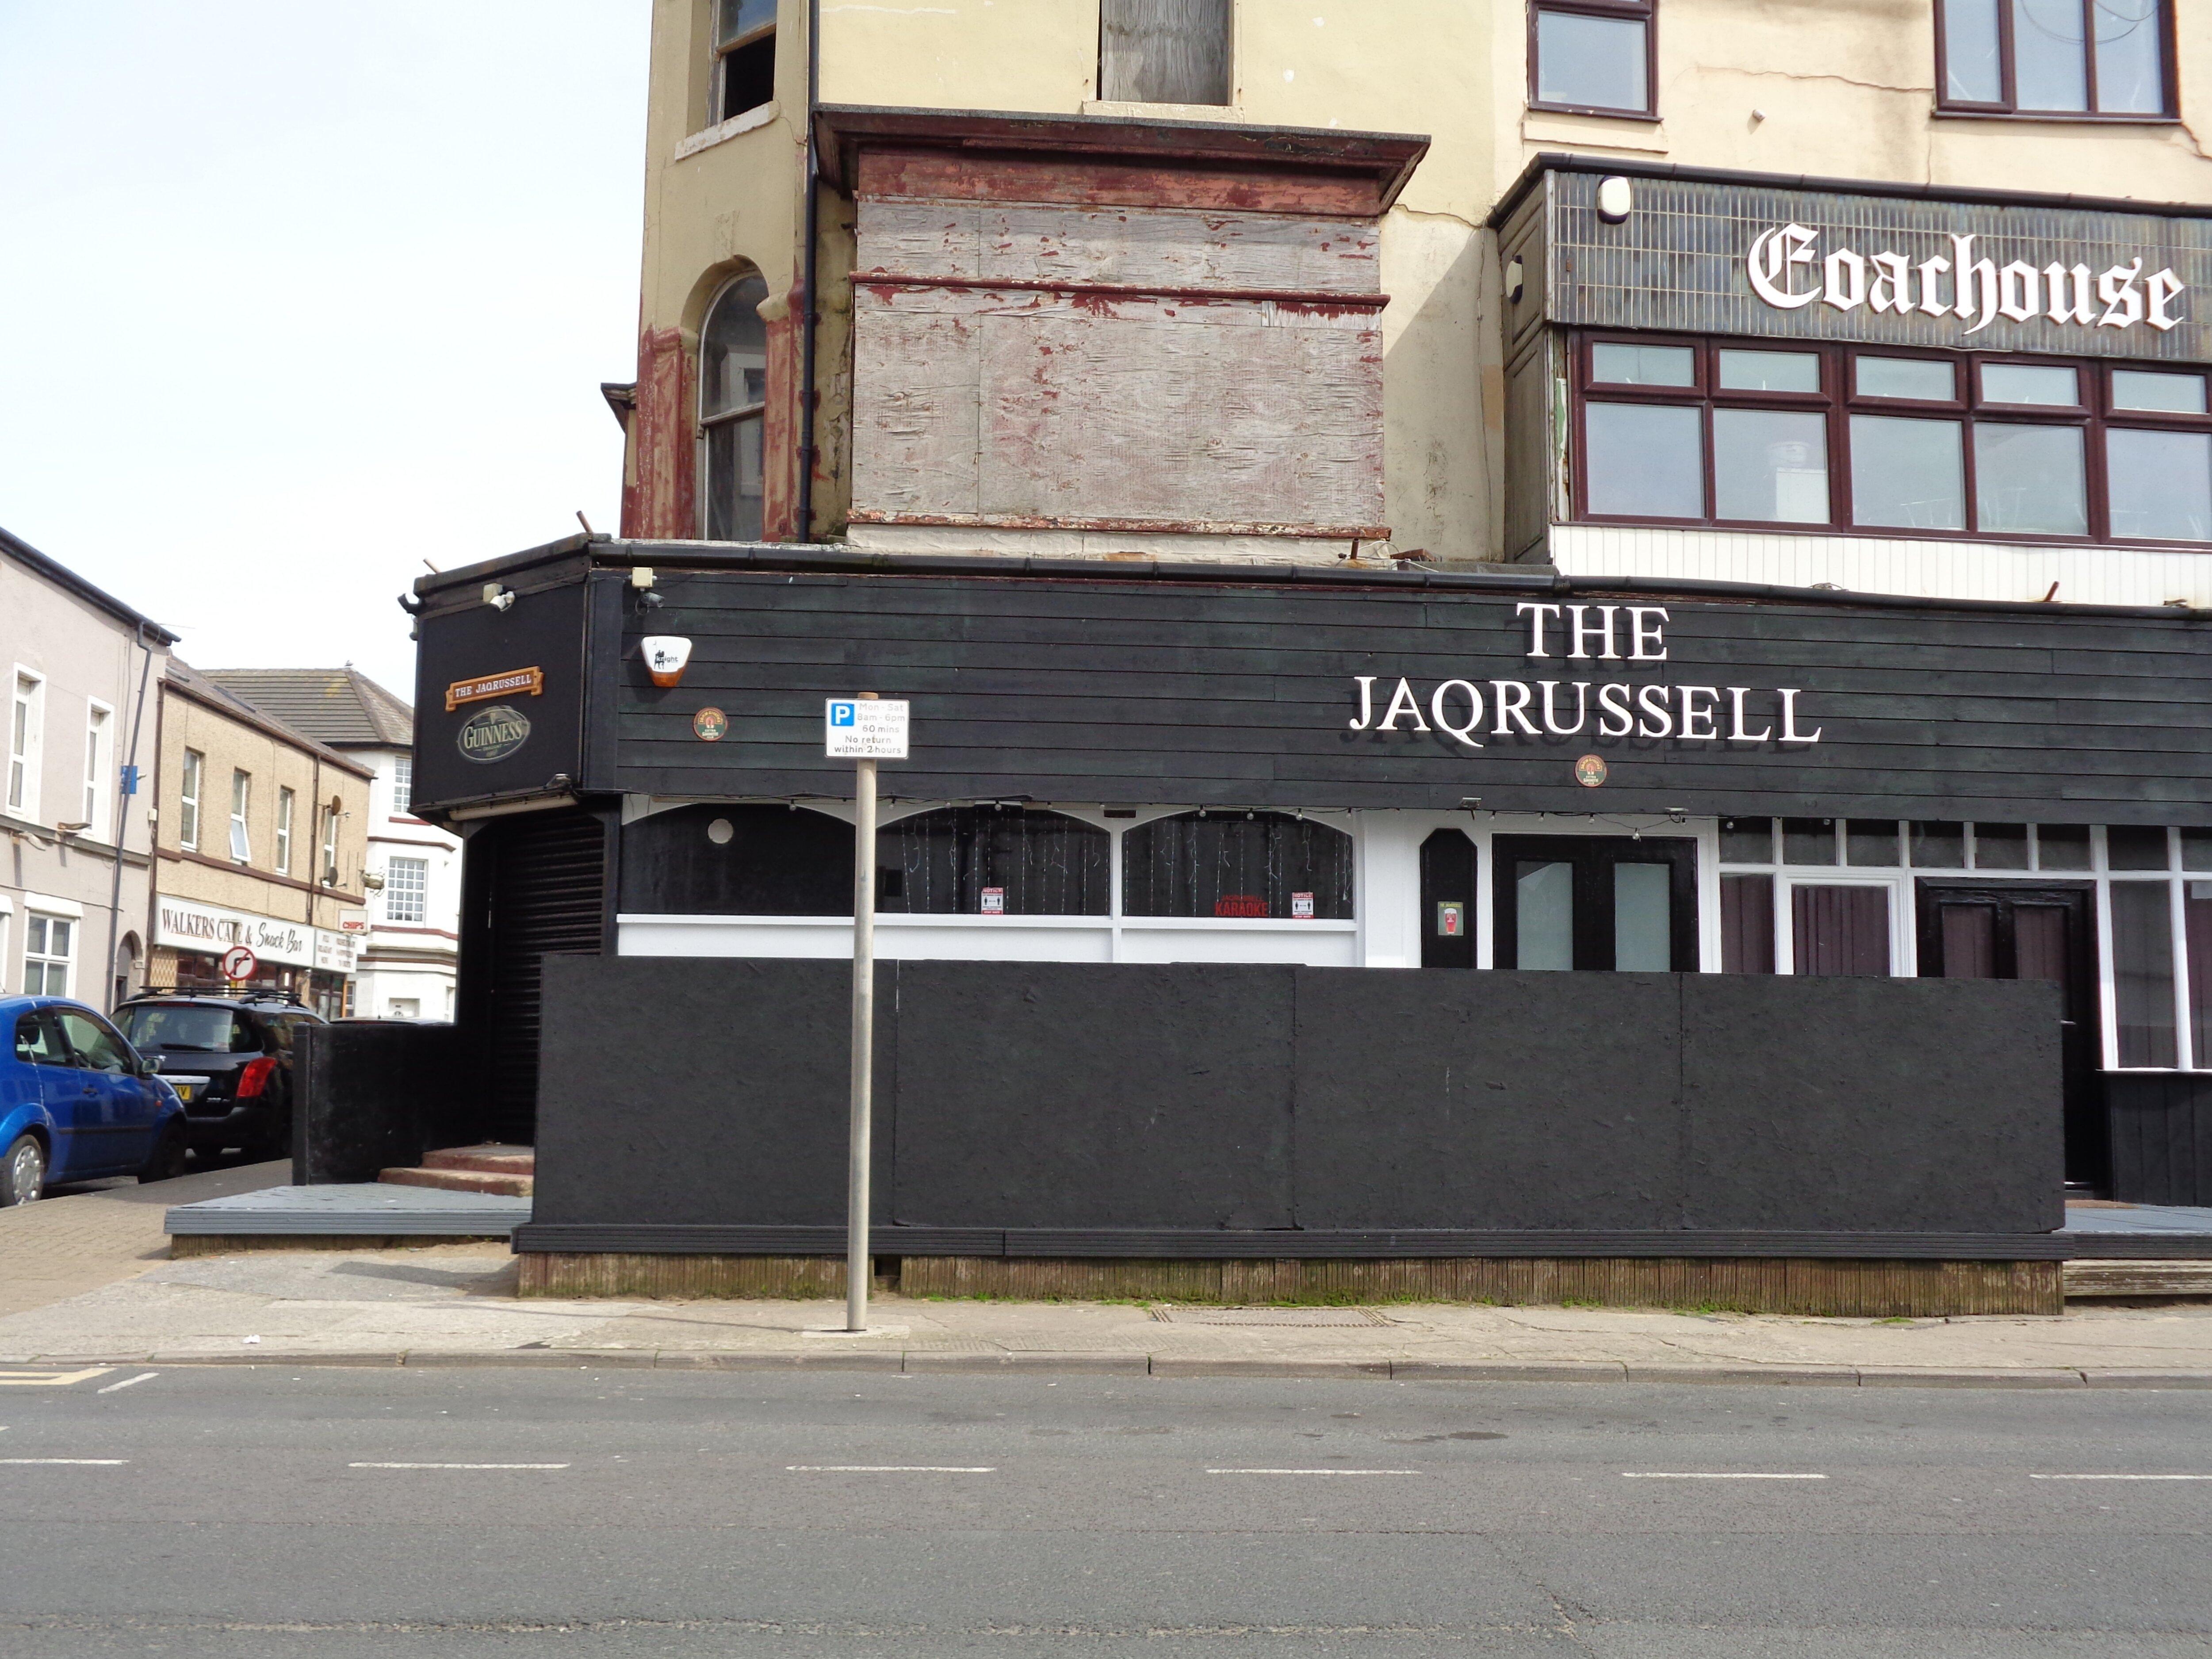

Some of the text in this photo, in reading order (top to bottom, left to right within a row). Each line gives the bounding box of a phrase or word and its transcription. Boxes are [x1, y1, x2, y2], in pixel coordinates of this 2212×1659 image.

[1748, 222, 2185, 335] Coachouse
[1516, 602, 1670, 660] THE
[455, 674, 531, 697] THE JAQRUSSELL
[835, 706, 850, 724] P
[1350, 676, 1822, 748] JAQRUSSELL
[464, 721, 522, 749] GUINNESS
[1215, 902, 1268, 917] KARAOKE
[162, 909, 214, 940] WALKERS
[245, 925, 252, 944] &
[256, 922, 284, 948] Snack
[287, 929, 302, 953] Bar
